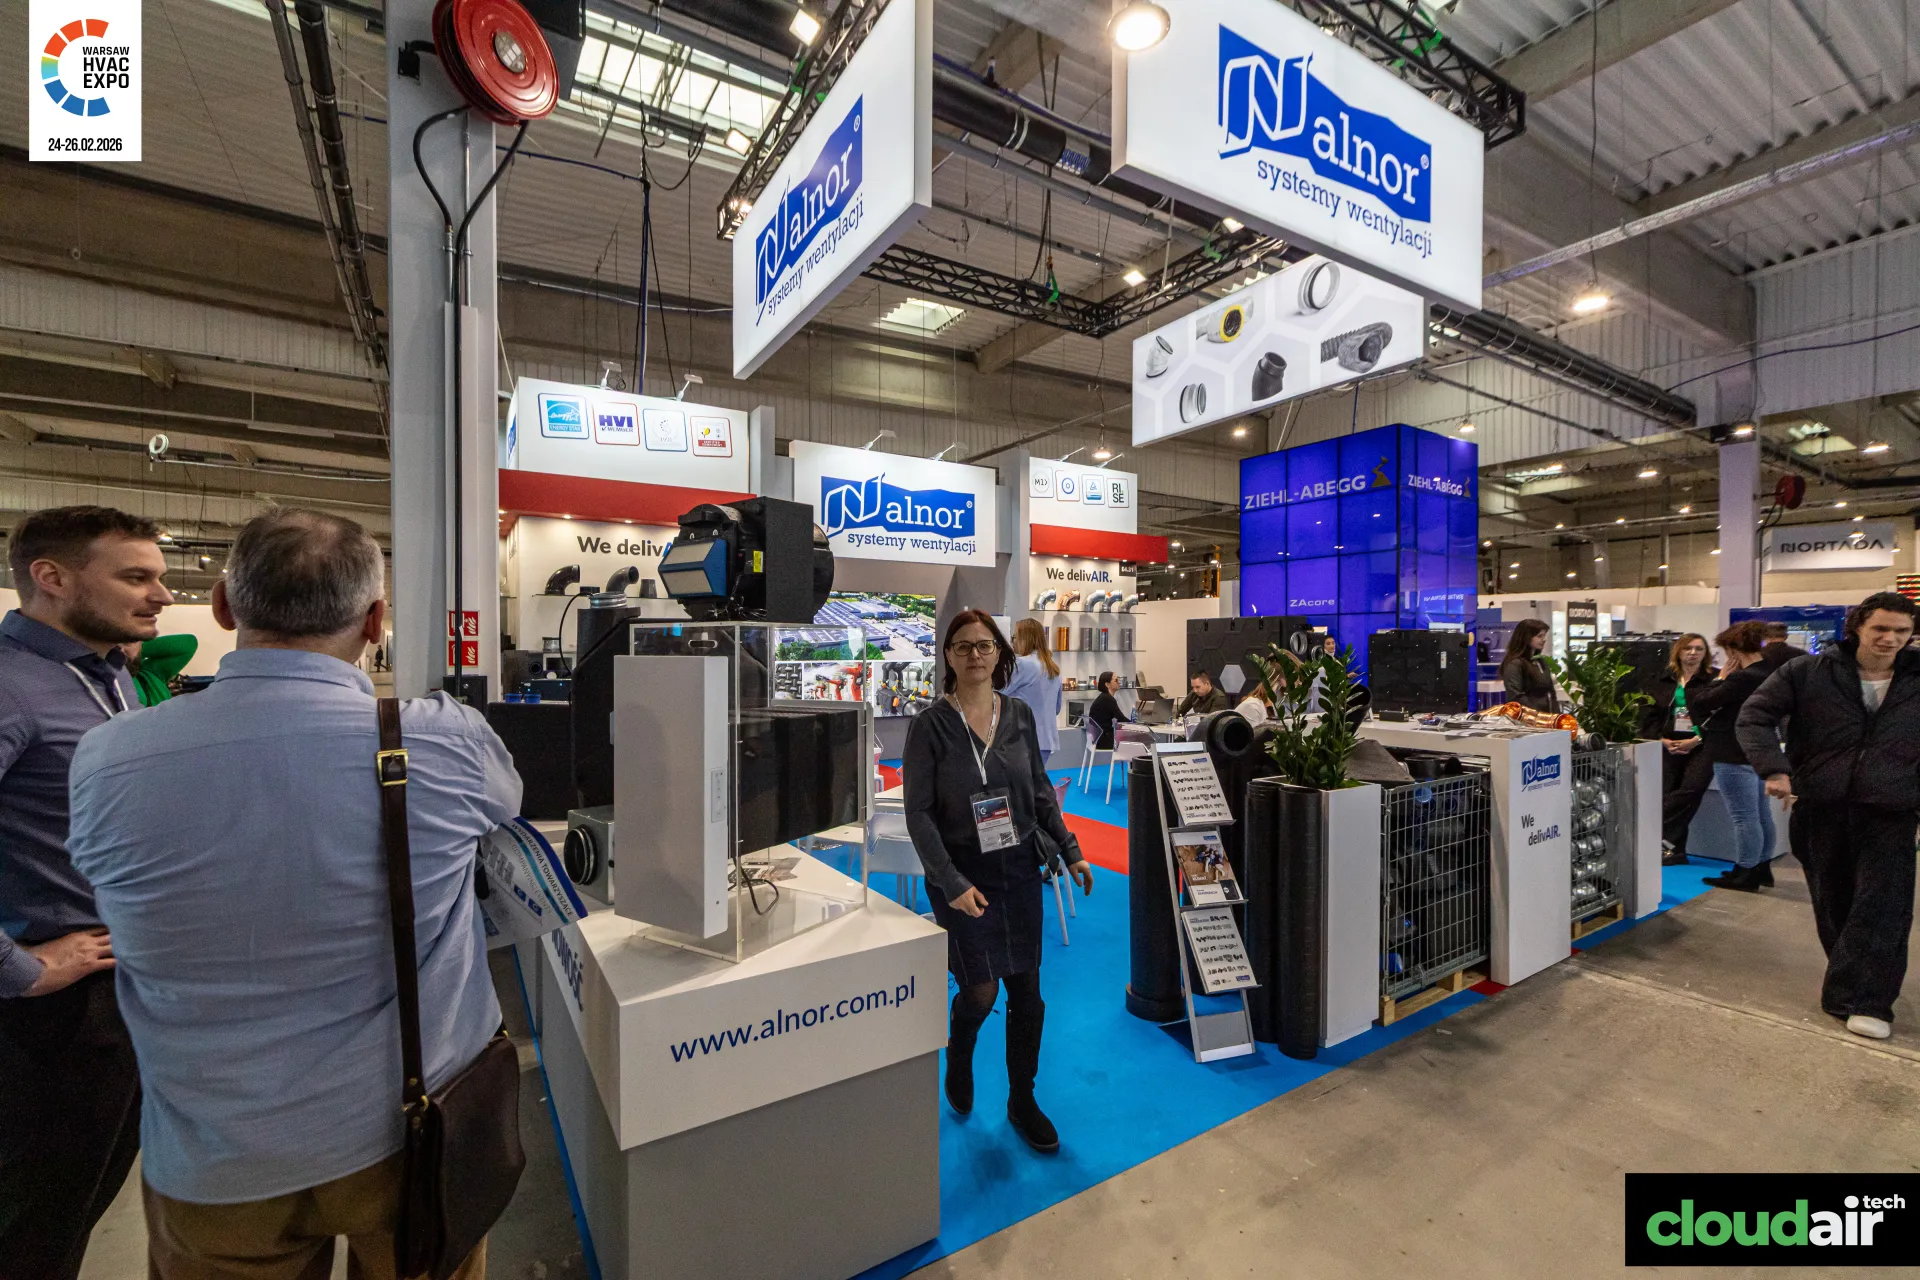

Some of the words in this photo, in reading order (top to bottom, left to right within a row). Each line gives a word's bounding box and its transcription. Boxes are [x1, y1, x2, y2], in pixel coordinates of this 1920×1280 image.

[1256, 159, 1342, 218] systemy
[1346, 199, 1432, 259] wentylacji
[768, 264, 804, 316] systemy
[805, 192, 864, 276] wentylacji
[599, 414, 634, 428] HVI
[1244, 475, 1366, 510] ZIEHL-ABEGG
[1408, 474, 1463, 496] ZIEHL-ABEGG
[1112, 493, 1125, 503] SE
[885, 495, 965, 529] alnor
[576, 536, 612, 554] We
[847, 533, 907, 550] systemy
[910, 537, 977, 555] wentylacji
[1046, 567, 1065, 580] We
[1067, 568, 1113, 583] delivAIR.
[1289, 598, 1336, 608] ZAcore
[1521, 813, 1535, 829] We
[1528, 824, 1561, 847] delivAIR.
[541, 864, 574, 917] TOWARZYSZĄCE
[670, 975, 917, 1063] www.alnor.com.pl
